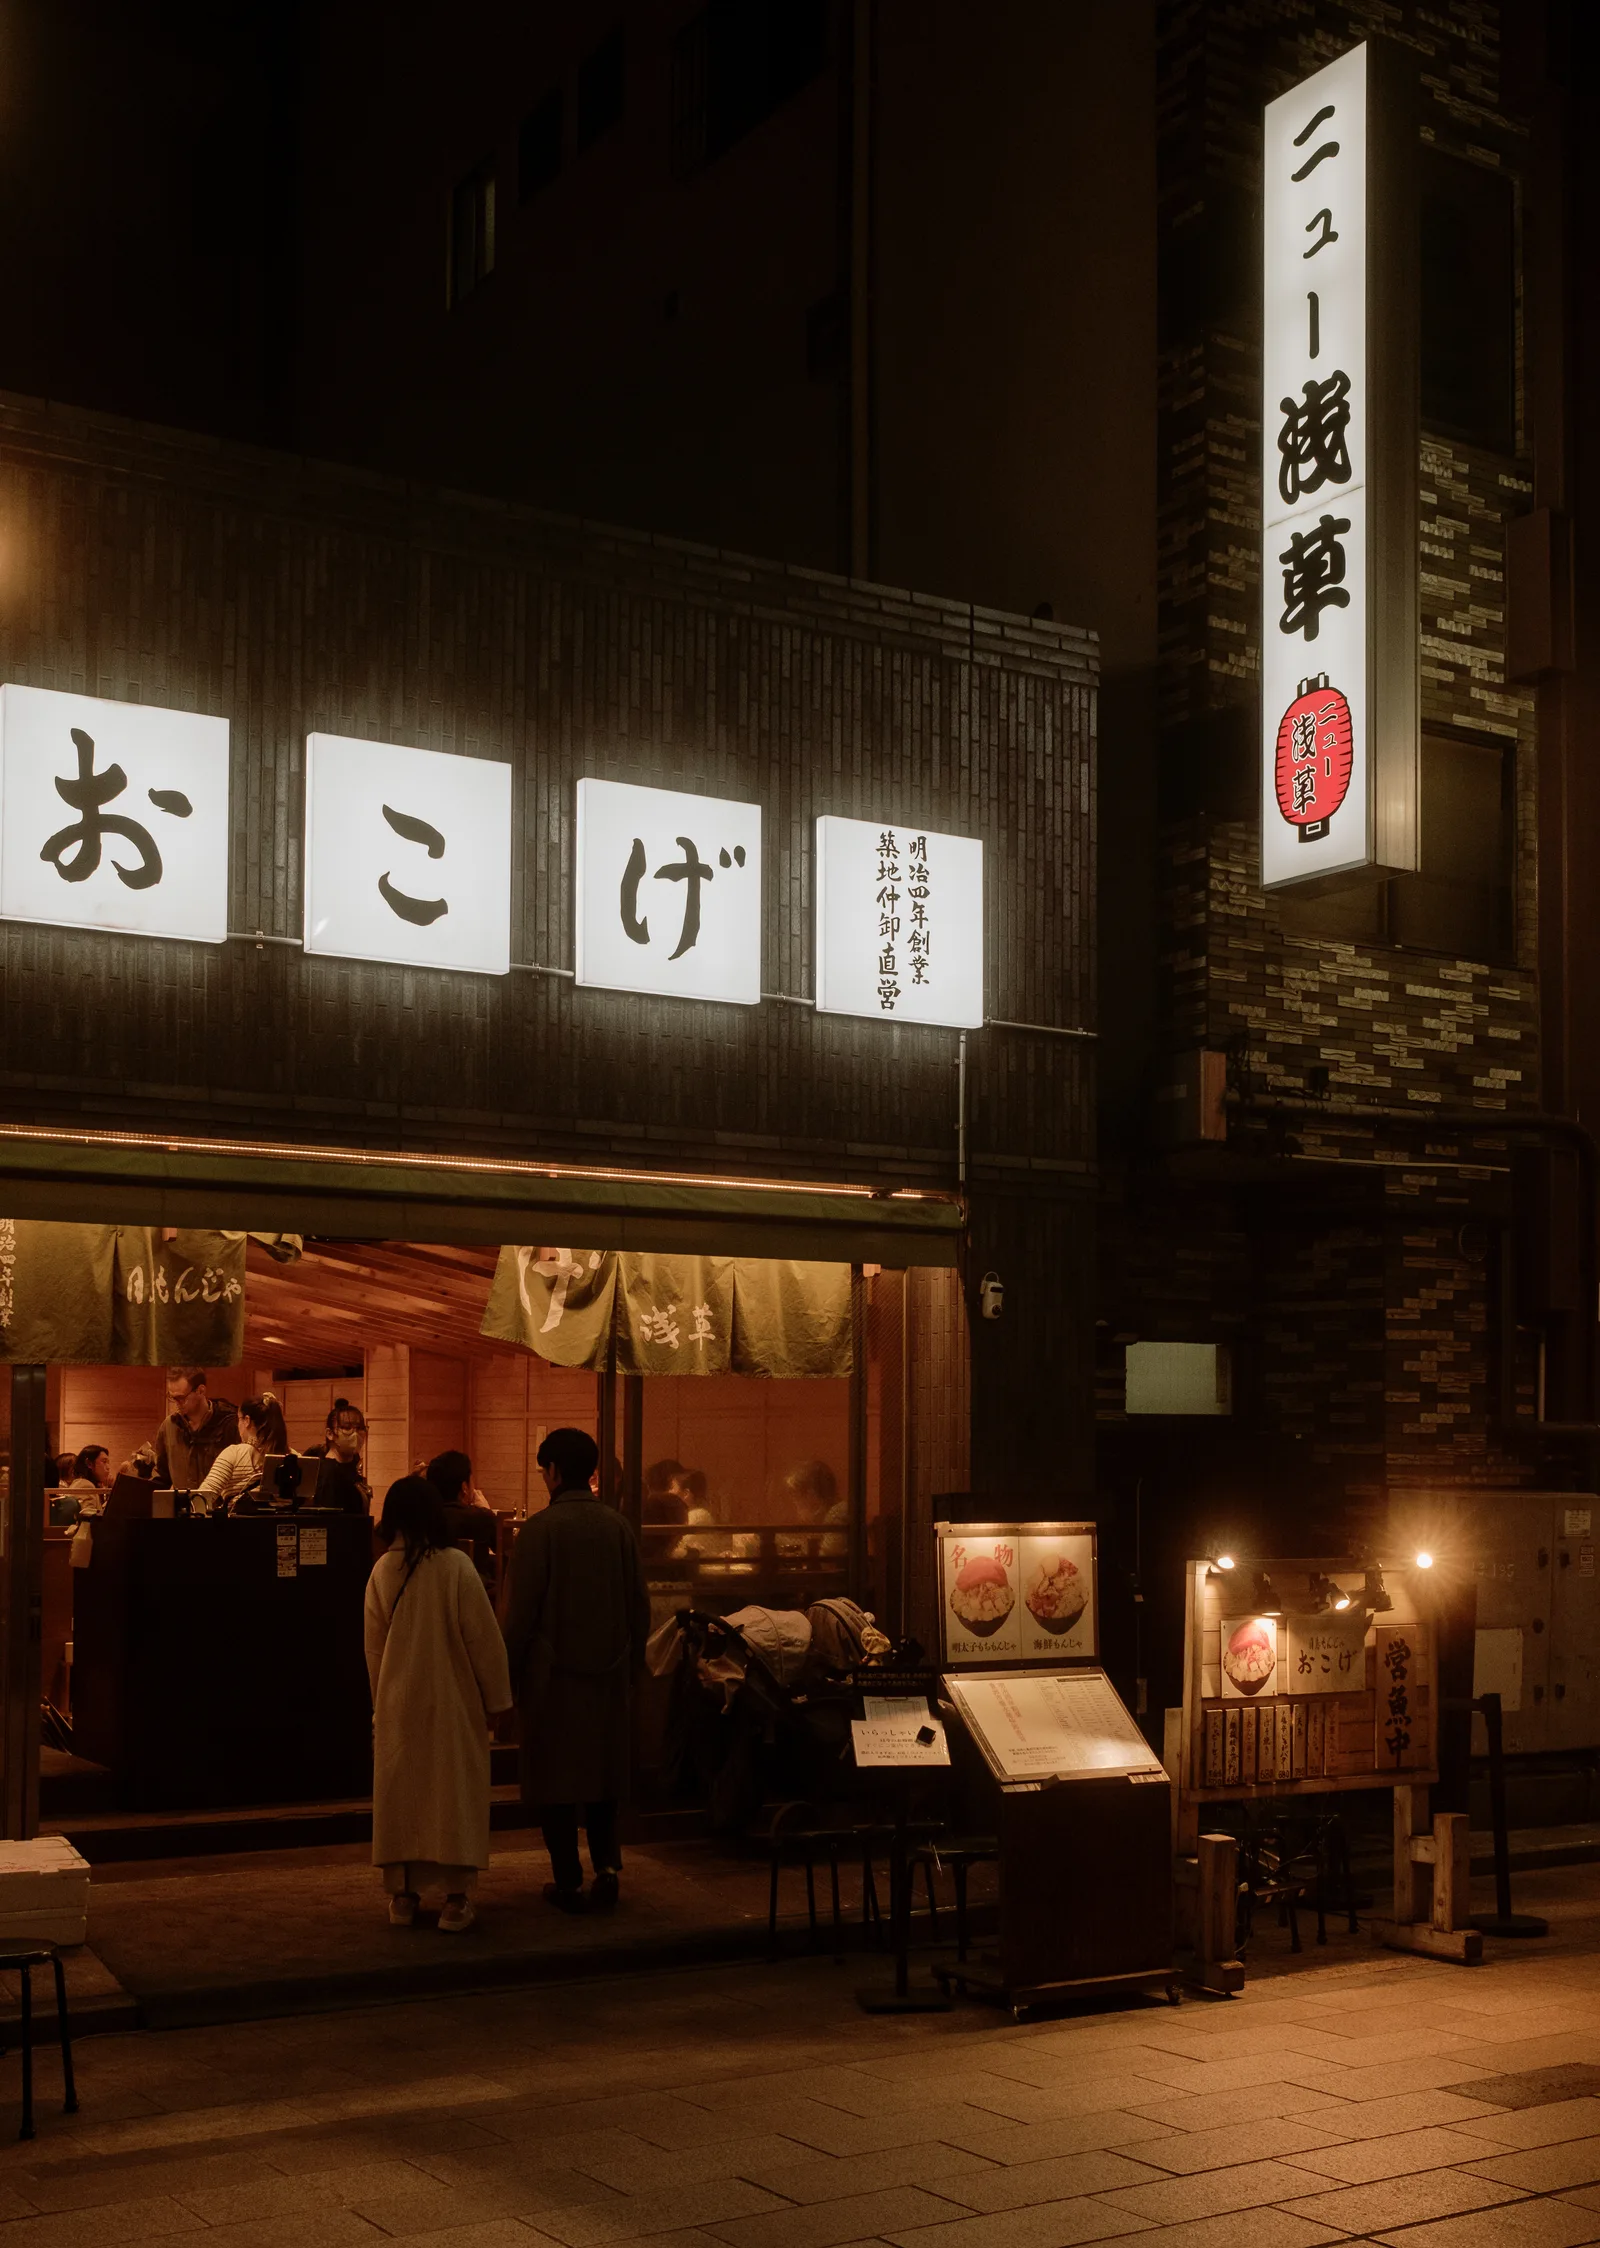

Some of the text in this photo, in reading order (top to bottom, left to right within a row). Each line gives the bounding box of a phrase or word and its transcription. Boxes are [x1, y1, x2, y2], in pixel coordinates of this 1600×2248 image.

[1278, 105, 1351, 642] ニュー浅草
[1292, 712, 1317, 816] 浅草
[1318, 702, 1338, 777] ニュー
[875, 830, 902, 1010] 築地仲卸直営
[907, 835, 930, 985] 明治四年創業
[639, 1303, 716, 1351] 浅草
[950, 1543, 1014, 1569] 名物
[1033, 1638, 1083, 1650] 海鮮もんじゃ
[1298, 1649, 1358, 1674] おこげ
